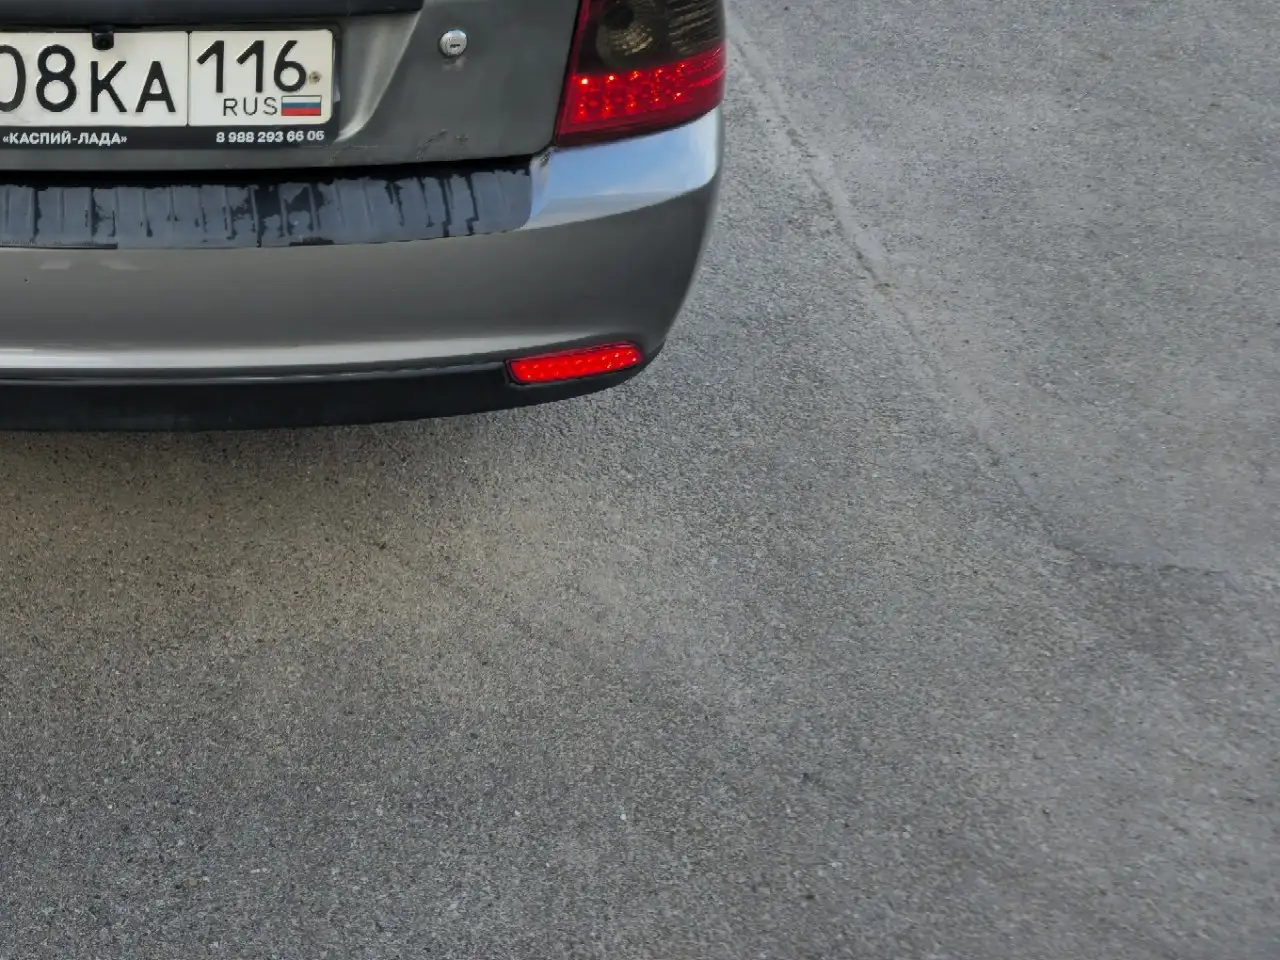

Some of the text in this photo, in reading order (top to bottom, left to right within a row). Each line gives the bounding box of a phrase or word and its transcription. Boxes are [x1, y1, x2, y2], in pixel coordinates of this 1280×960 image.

[196, 40, 307, 94] 116
[223, 96, 278, 117] RUS
[3, 130, 128, 147] «КАСПИЙ-ЛАДА»
[216, 132, 225, 143] 8
[228, 132, 255, 143] 988
[257, 131, 284, 143] 293
[286, 131, 304, 142] 66
